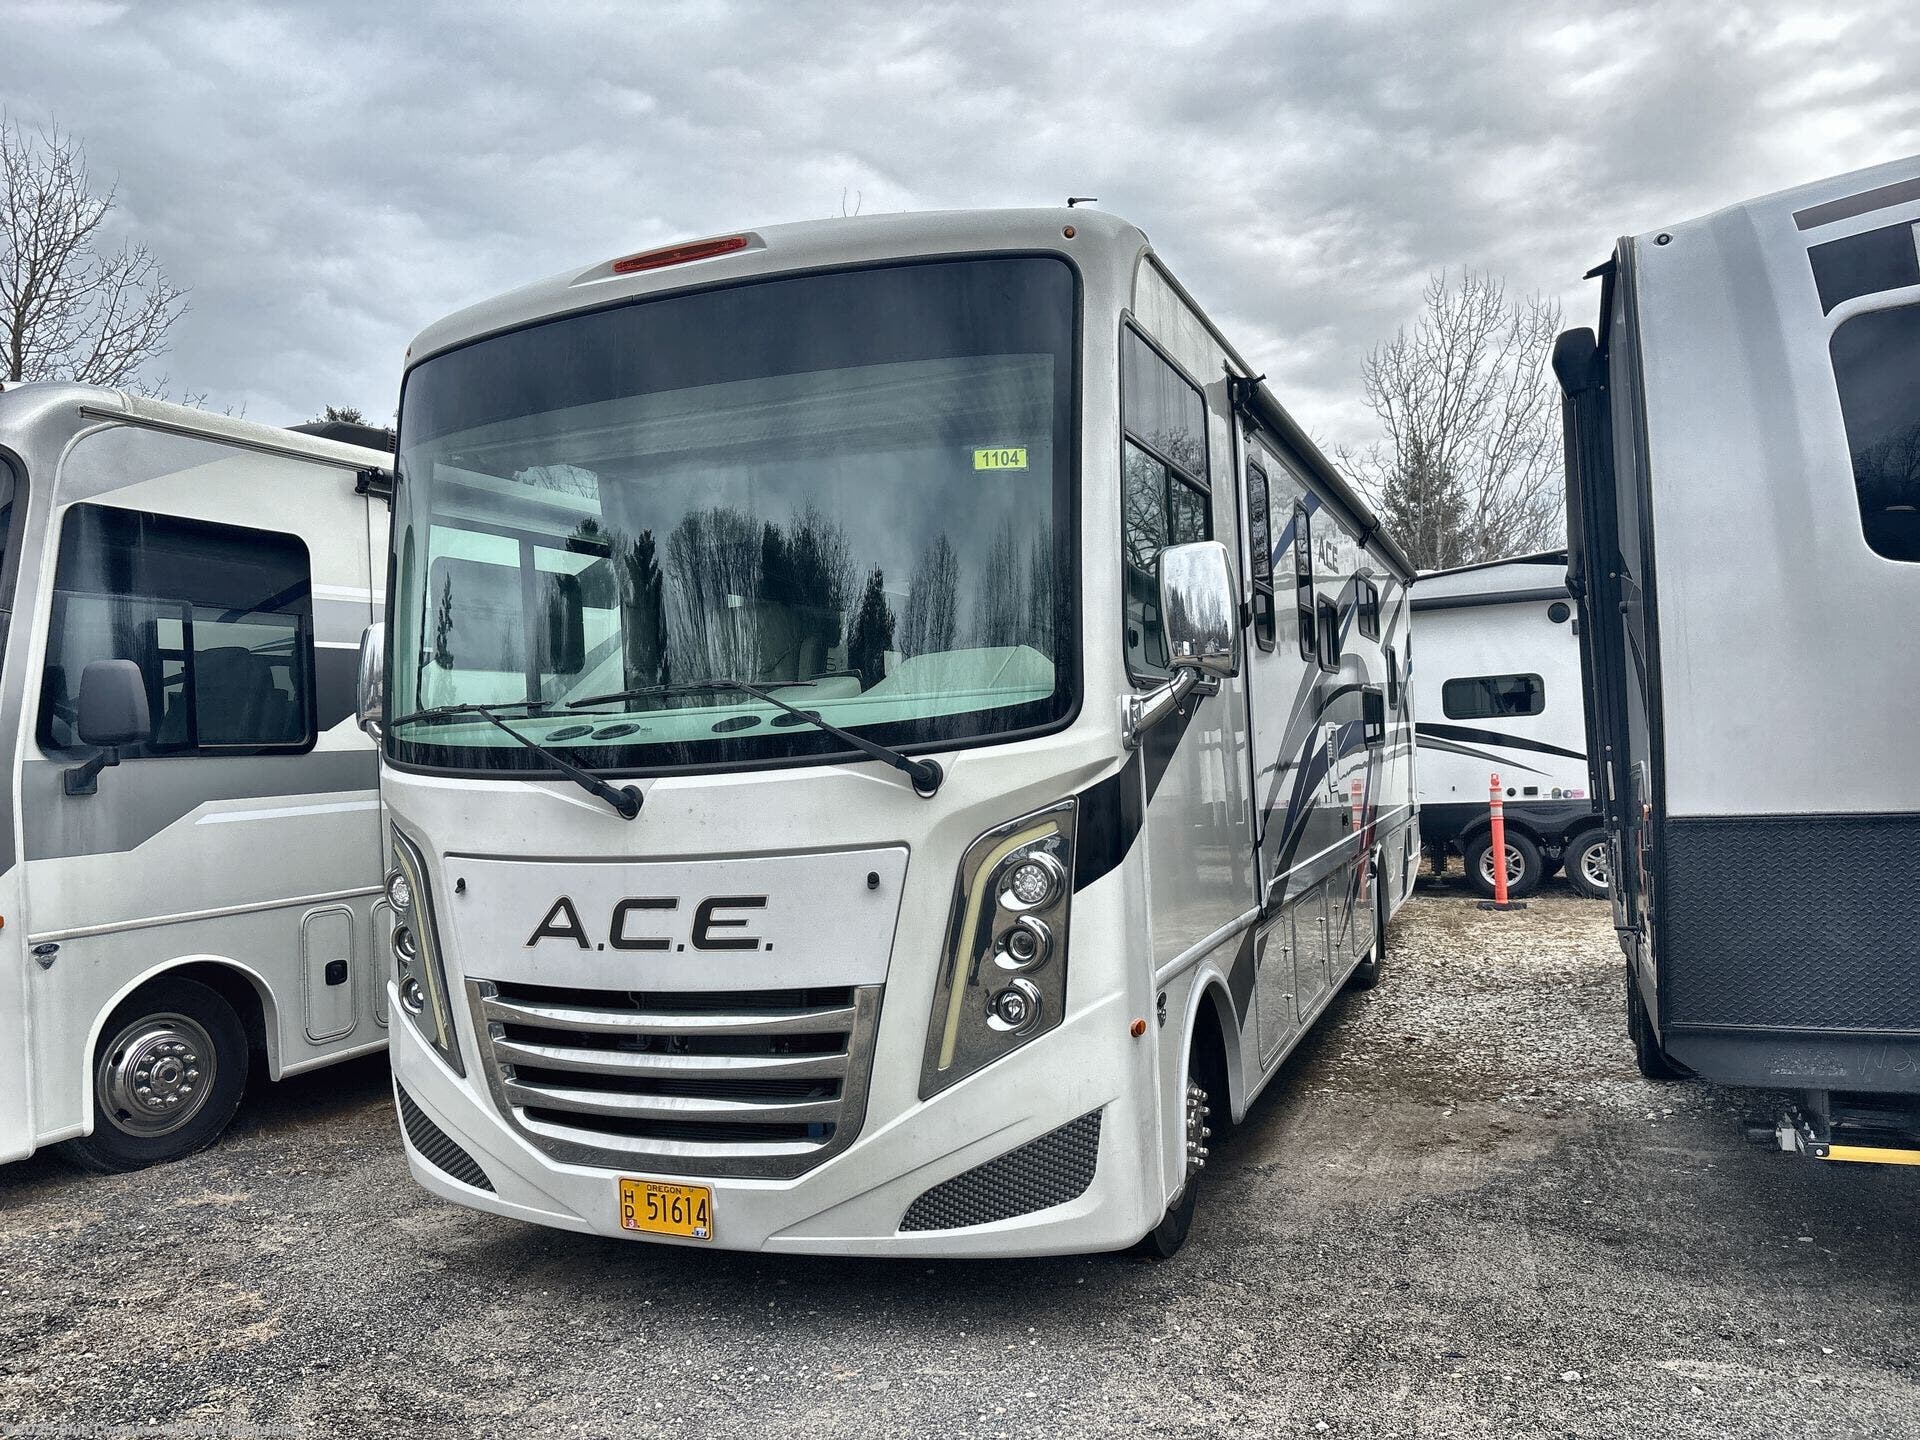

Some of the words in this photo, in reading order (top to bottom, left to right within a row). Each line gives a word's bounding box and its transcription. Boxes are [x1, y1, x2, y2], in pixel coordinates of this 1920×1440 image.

[982, 450, 1019, 467] 1104
[1318, 536, 1340, 575] ACE
[522, 895, 774, 951] A.C.E.
[646, 1184, 682, 1194] OREGON
[646, 1192, 708, 1227] 51614
